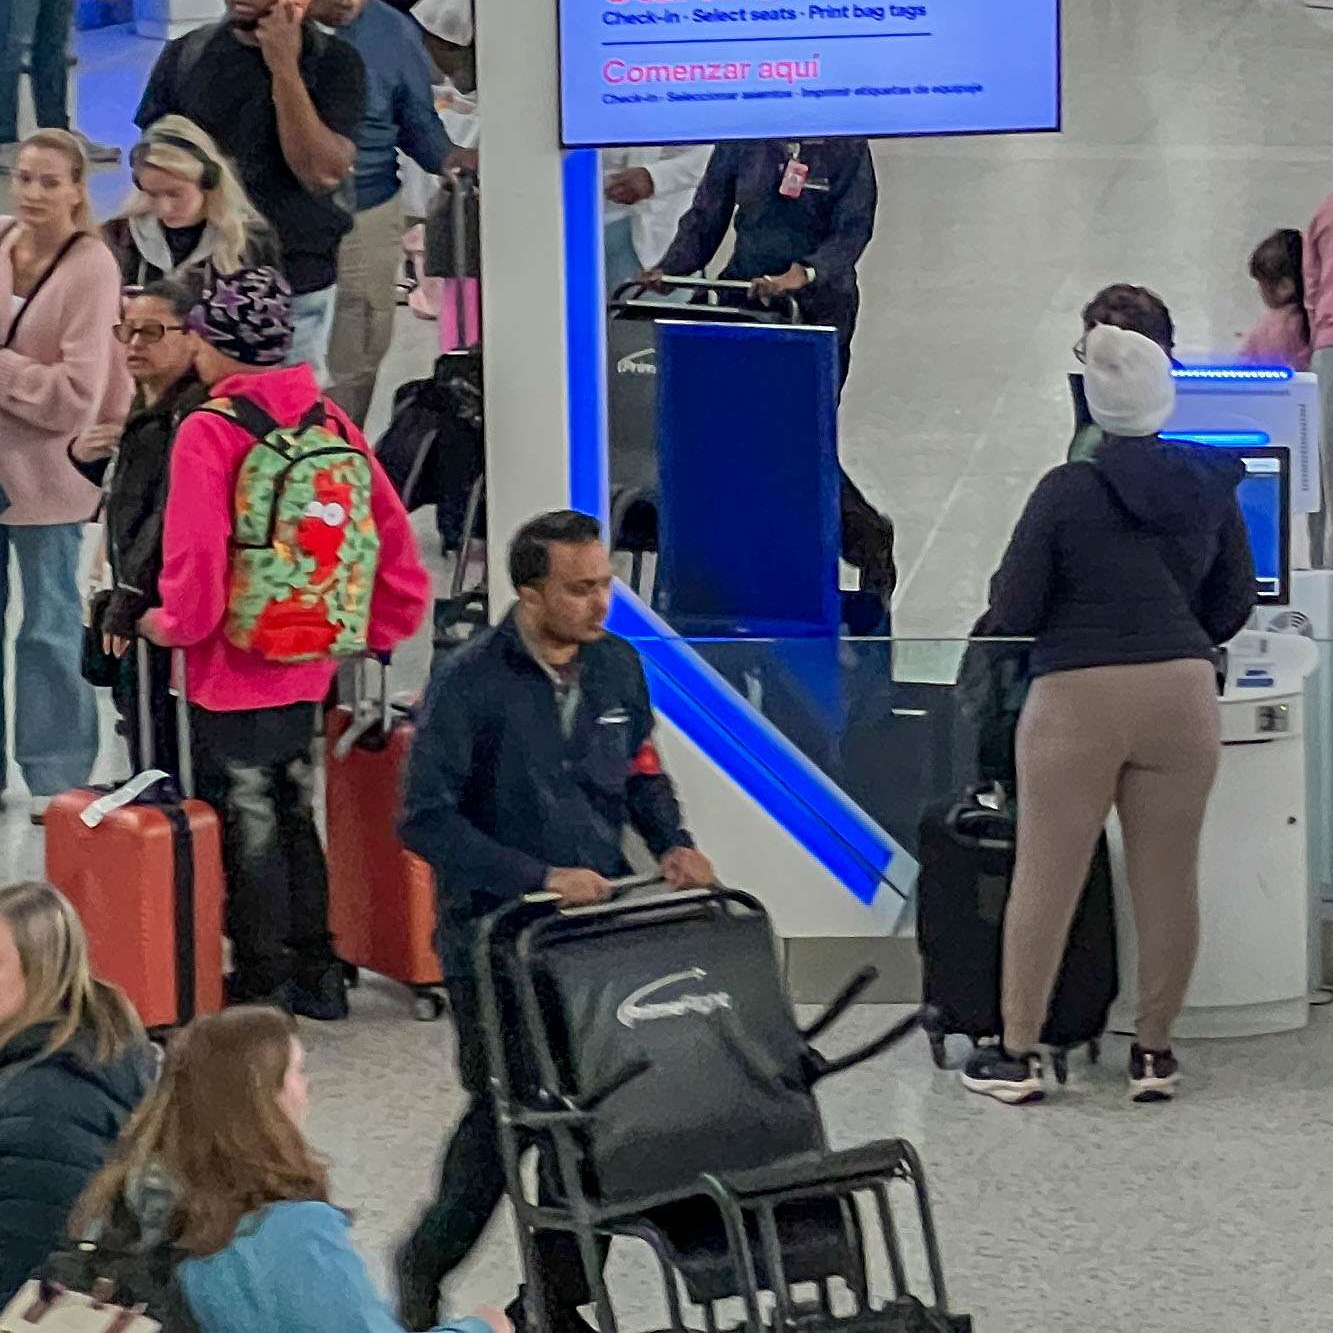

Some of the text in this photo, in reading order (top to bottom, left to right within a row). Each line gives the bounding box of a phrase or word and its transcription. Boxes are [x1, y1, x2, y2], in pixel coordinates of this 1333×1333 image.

[602, 4, 927, 26] Check-in Select seats Print bag tags
[602, 58, 752, 85] Comenzar
